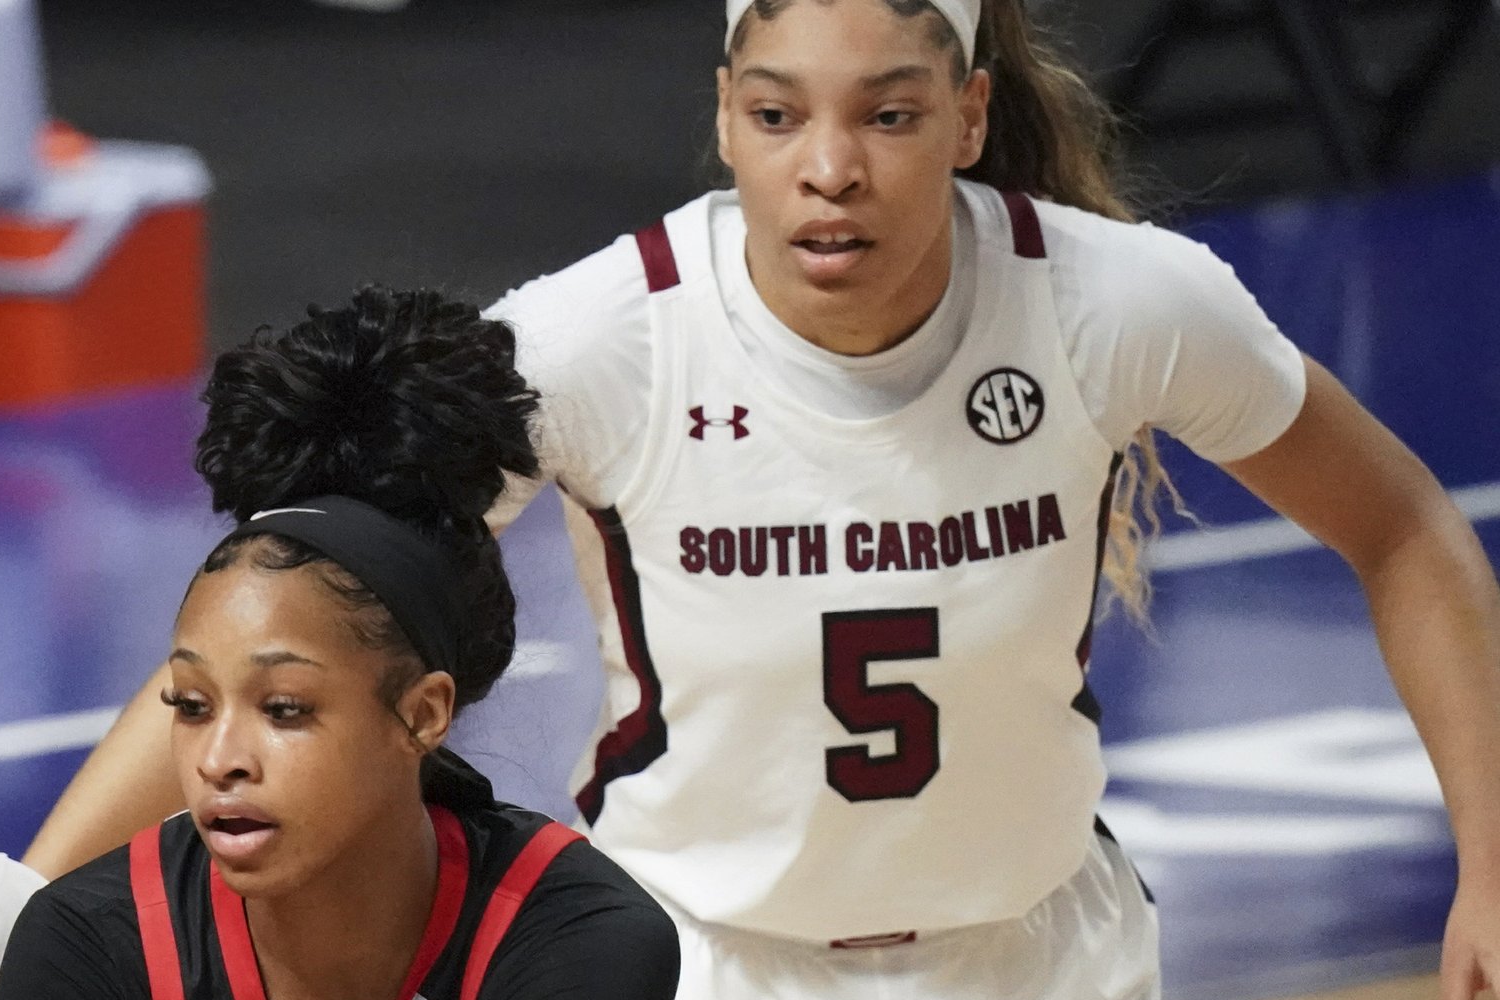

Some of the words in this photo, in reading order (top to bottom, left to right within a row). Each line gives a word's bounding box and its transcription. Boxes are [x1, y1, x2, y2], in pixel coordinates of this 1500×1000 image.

[970, 371, 1040, 440] SEC
[679, 524, 828, 577] SOUTH
[845, 493, 1067, 573] CAROLINA
[821, 606, 941, 803] 5
